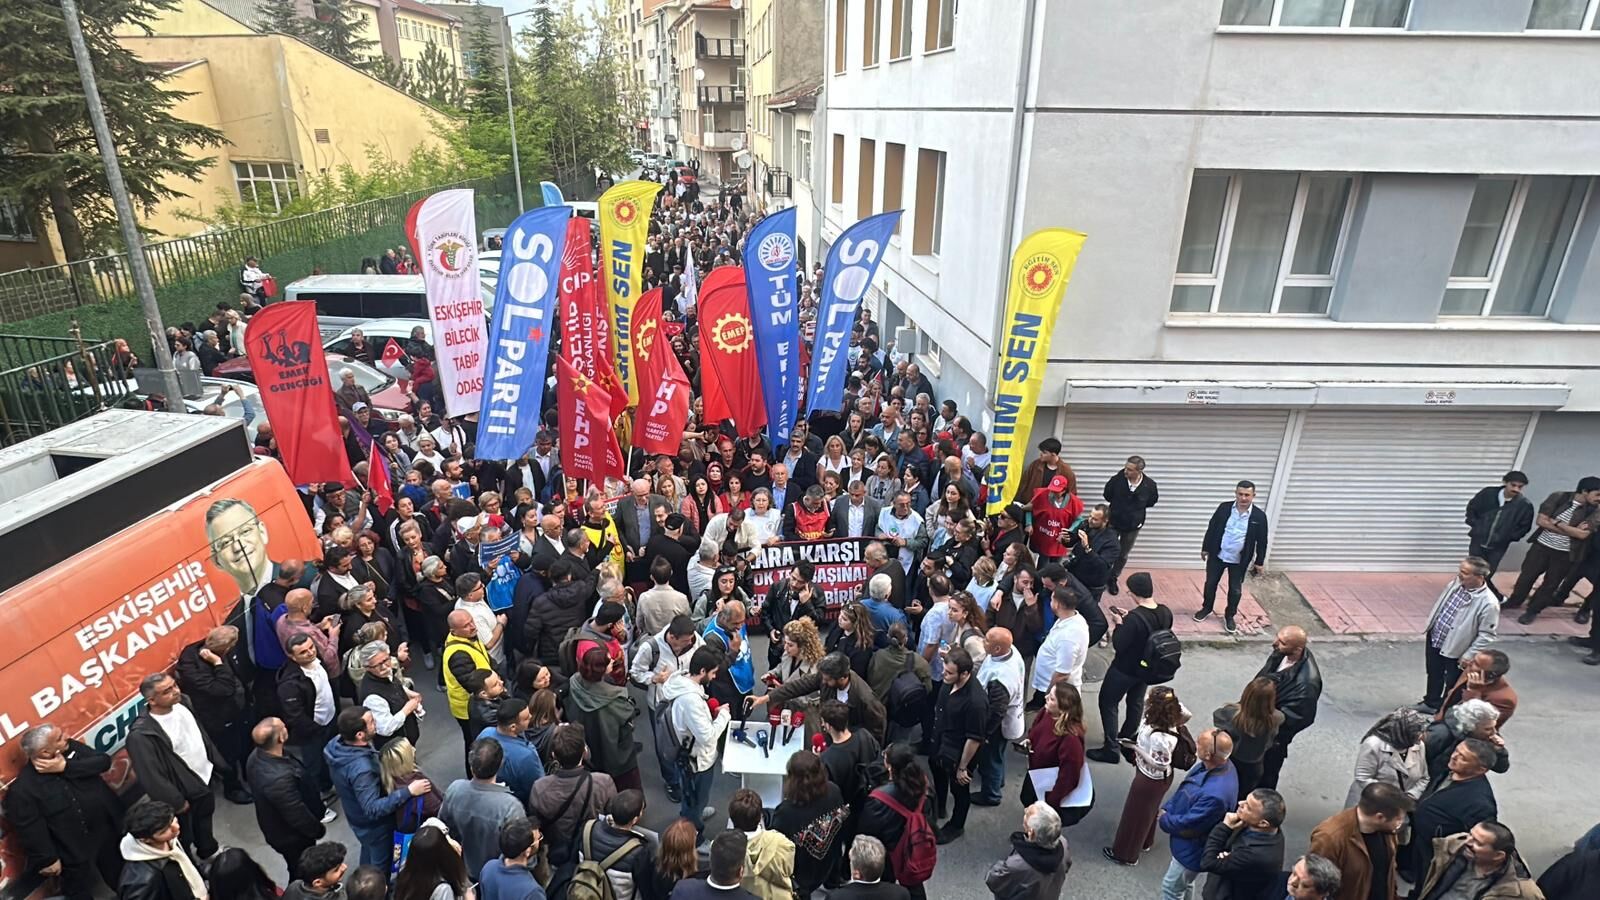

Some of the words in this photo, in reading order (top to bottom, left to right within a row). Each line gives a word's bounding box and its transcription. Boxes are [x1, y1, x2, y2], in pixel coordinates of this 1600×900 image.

[501, 226, 554, 331] SOL
[612, 239, 632, 299] SEN
[826, 238, 880, 327] SOL
[434, 297, 483, 322] ESKİŞEHİR
[768, 274, 792, 326] TÜM
[444, 324, 480, 347] BİLECİK
[453, 351, 480, 371] TABİP
[1002, 311, 1043, 384] SEN
[487, 338, 527, 436] PARTİ
[574, 398, 590, 449] EHP
[800, 541, 861, 566] KARŞI
[74, 560, 206, 652] ESKİŞEHİR
[30, 583, 217, 719] BAŞKANLIĞI
